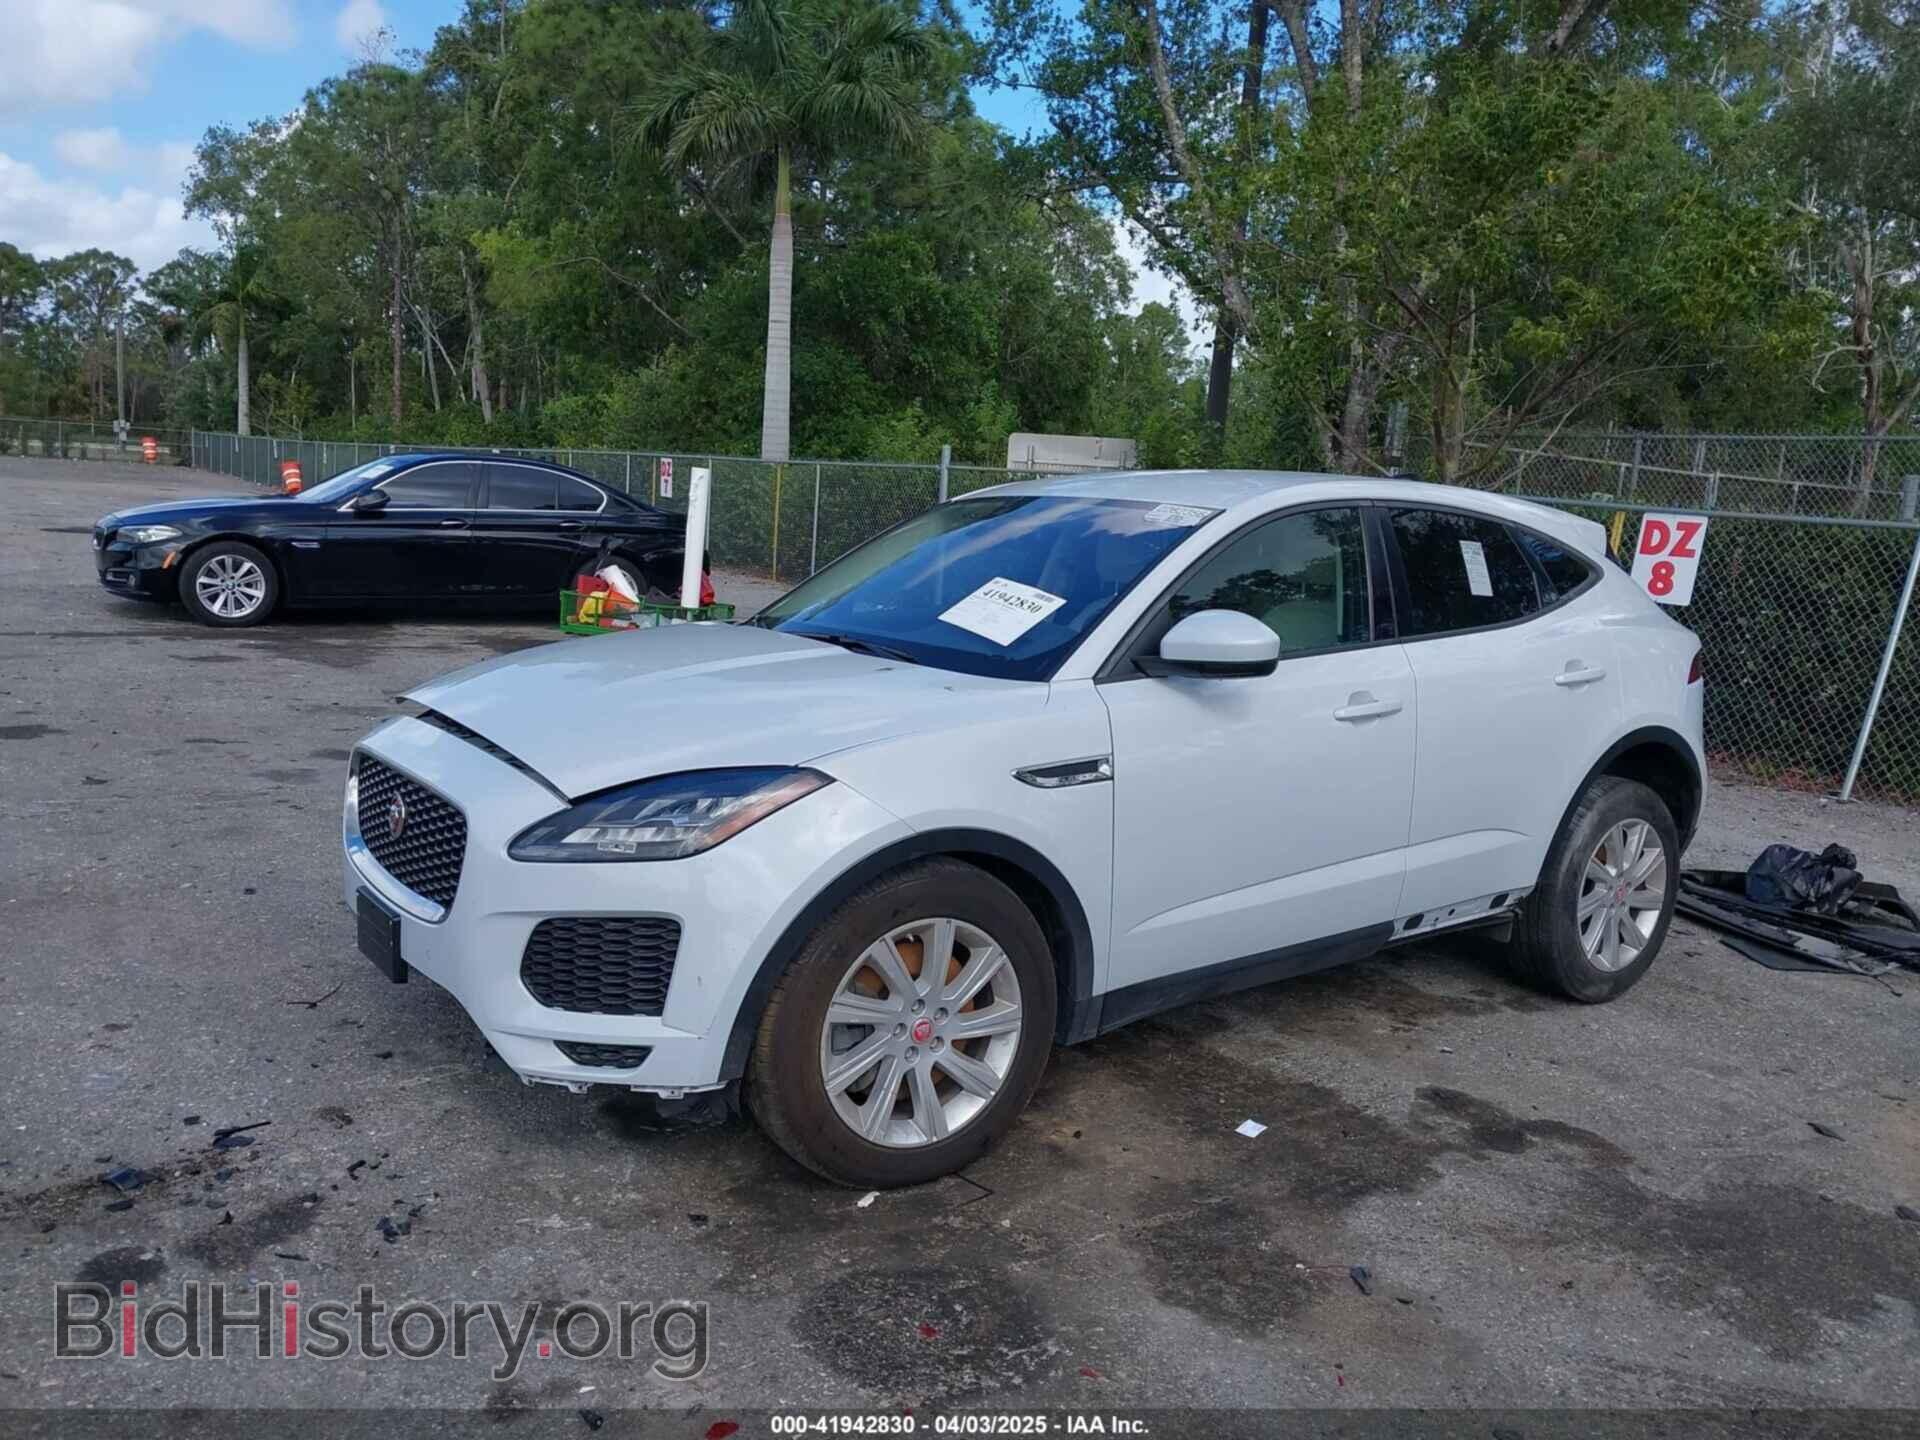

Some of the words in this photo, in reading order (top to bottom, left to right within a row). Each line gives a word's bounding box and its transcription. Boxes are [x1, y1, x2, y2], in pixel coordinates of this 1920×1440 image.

[1639, 519, 1703, 558] DZ
[1647, 560, 1675, 596] 8
[983, 589, 1042, 613] 41942830
